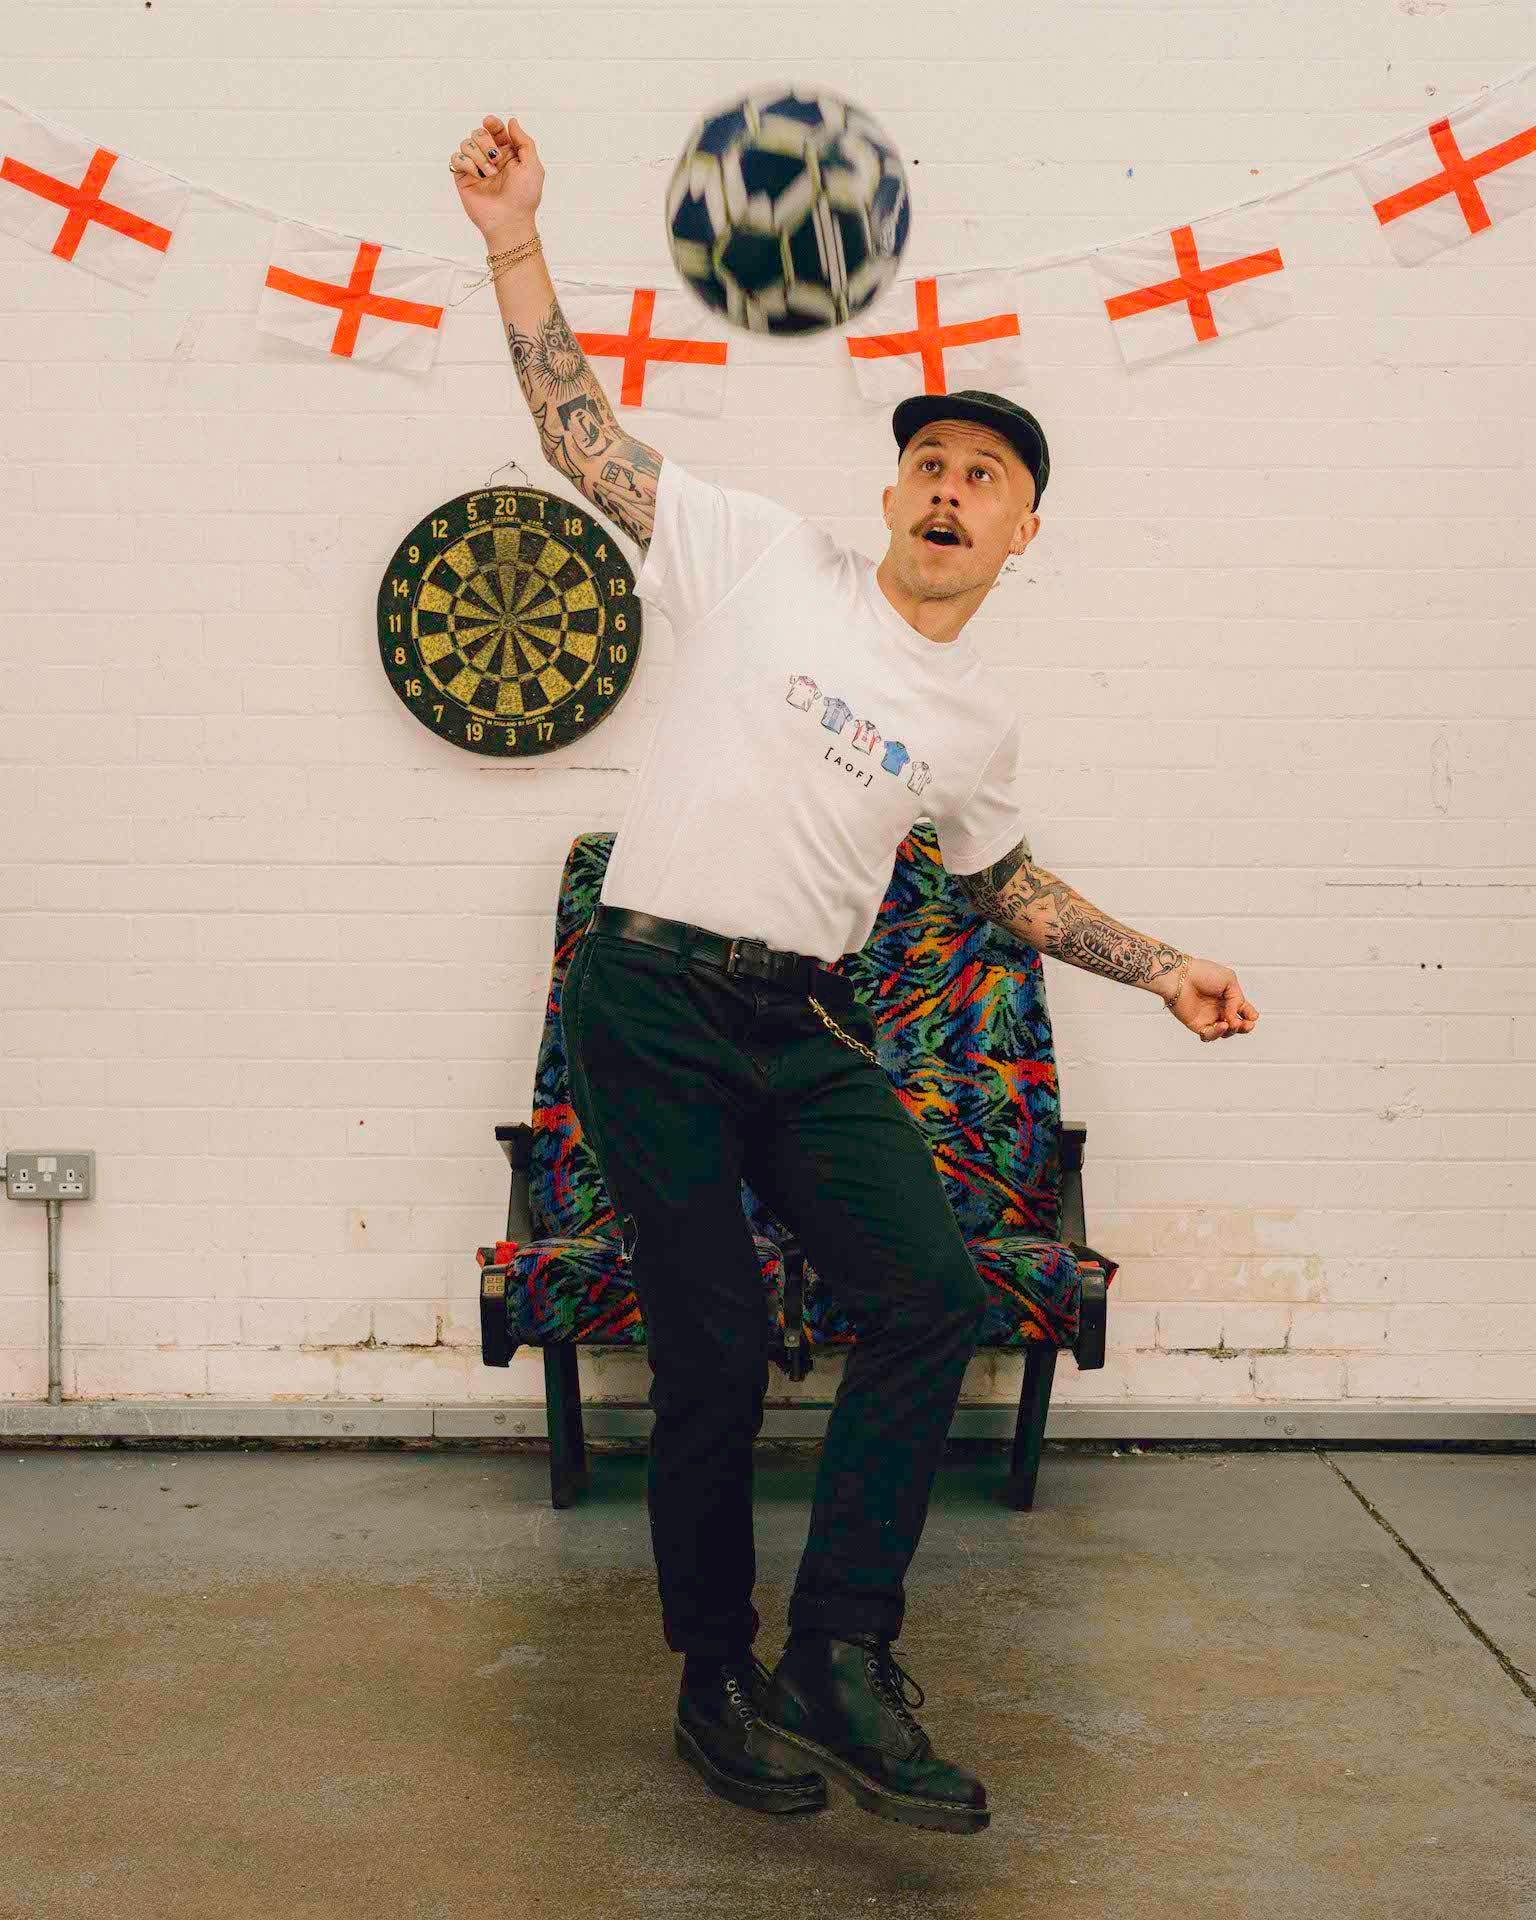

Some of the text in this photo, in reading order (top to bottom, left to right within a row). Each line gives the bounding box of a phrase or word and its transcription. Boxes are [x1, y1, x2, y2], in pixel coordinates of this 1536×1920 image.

[466, 502, 478, 521] 5
[494, 497, 516, 515] 20
[538, 502, 544, 519] 1
[431, 520, 448, 537] 12
[564, 518, 582, 536] 18
[409, 546, 419, 563] 9
[595, 544, 607, 561] 4
[392, 579, 409, 597] 14
[609, 579, 626, 596] 13
[389, 615, 401, 632] 11
[615, 614, 626, 631] 6
[395, 647, 406, 664] 8
[610, 645, 626, 663] 10
[405, 679, 421, 696] 16
[597, 677, 613, 695] 15
[434, 705, 444, 722] 7
[472, 715, 486, 723] MADE
[575, 704, 584, 721] 2
[466, 722, 483, 741] 19
[506, 729, 516, 745] 3
[537, 722, 554, 741] 17
